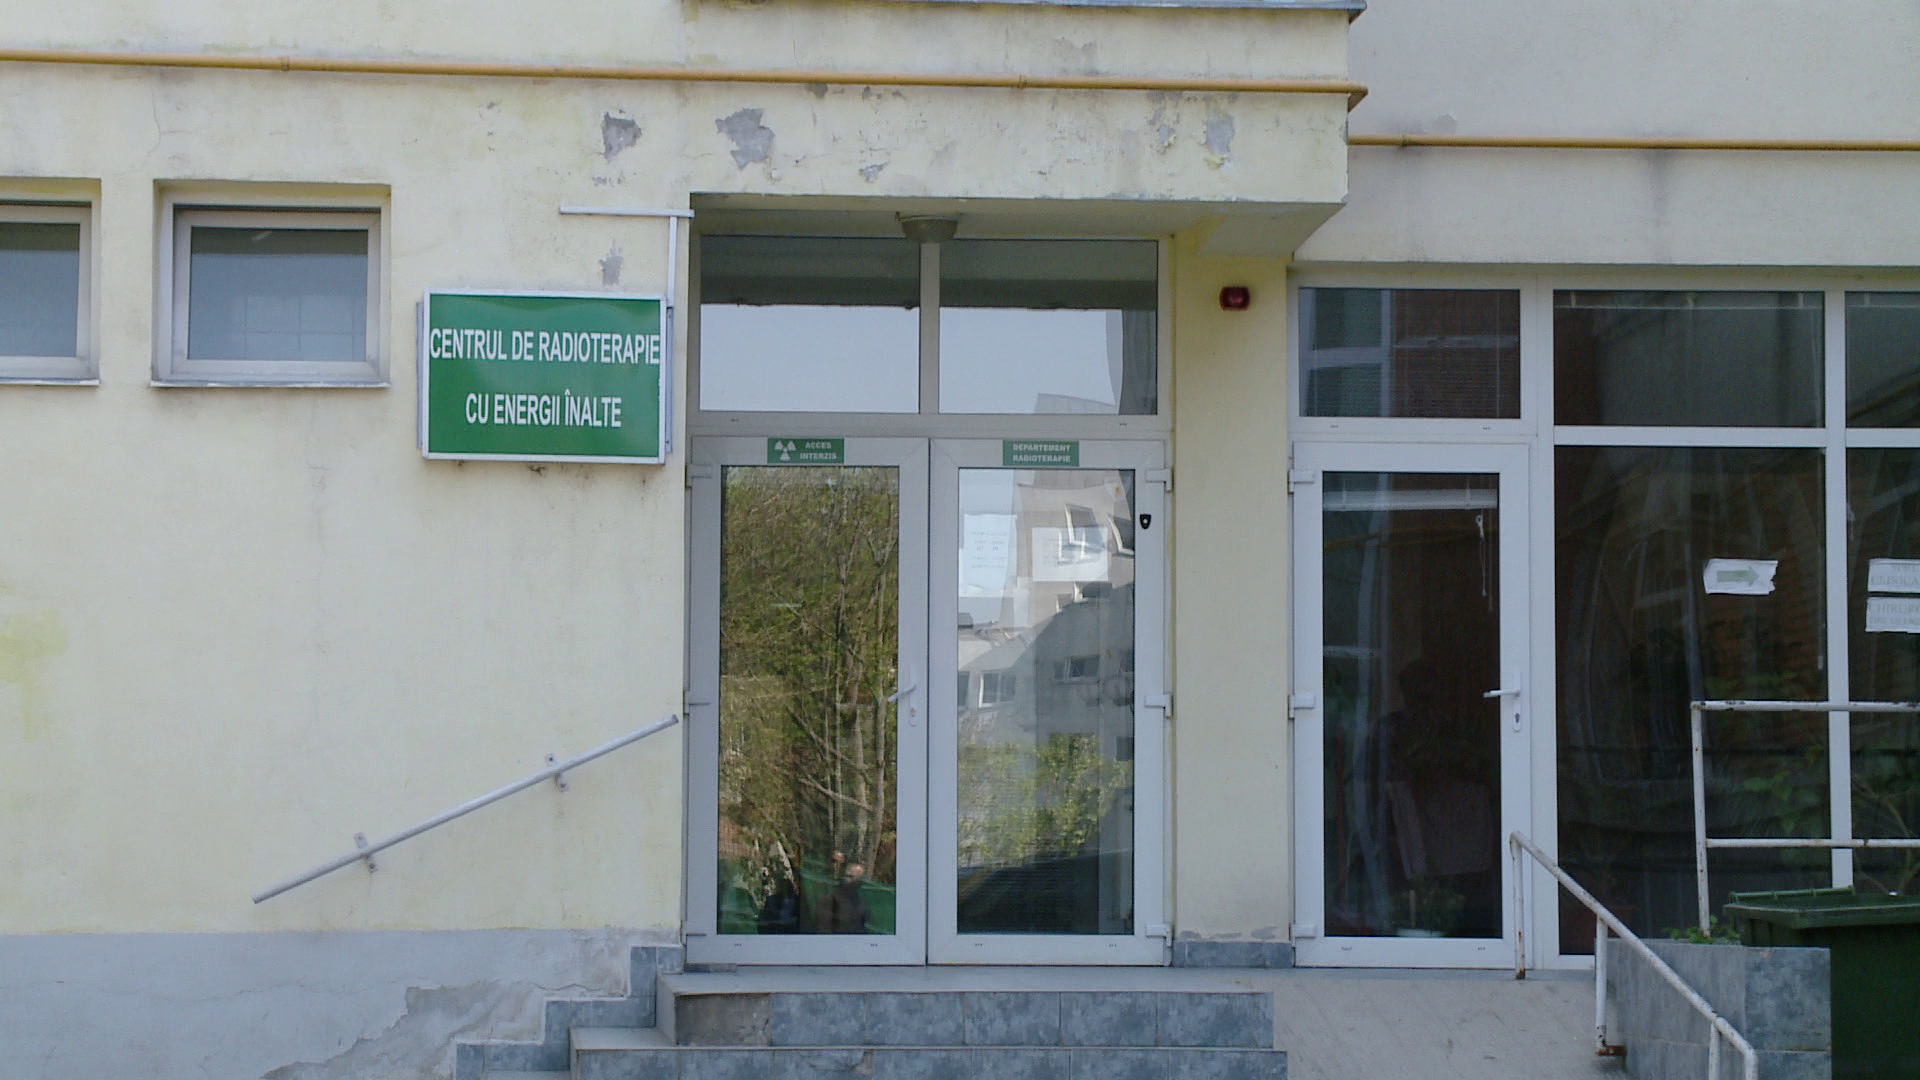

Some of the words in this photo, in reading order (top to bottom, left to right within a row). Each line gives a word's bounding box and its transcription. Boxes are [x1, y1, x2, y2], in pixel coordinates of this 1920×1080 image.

[430, 328, 507, 360] CENTRUL
[511, 330, 534, 361] DE
[539, 332, 660, 364] RADIOTERAPIE
[466, 393, 489, 424] CU
[494, 394, 560, 426] ENERGII
[565, 389, 622, 428] ÎNALTE
[805, 441, 832, 449] ACCES
[800, 452, 837, 460] INTERZIS
[1013, 454, 1071, 463] RADIOTERAPIE
